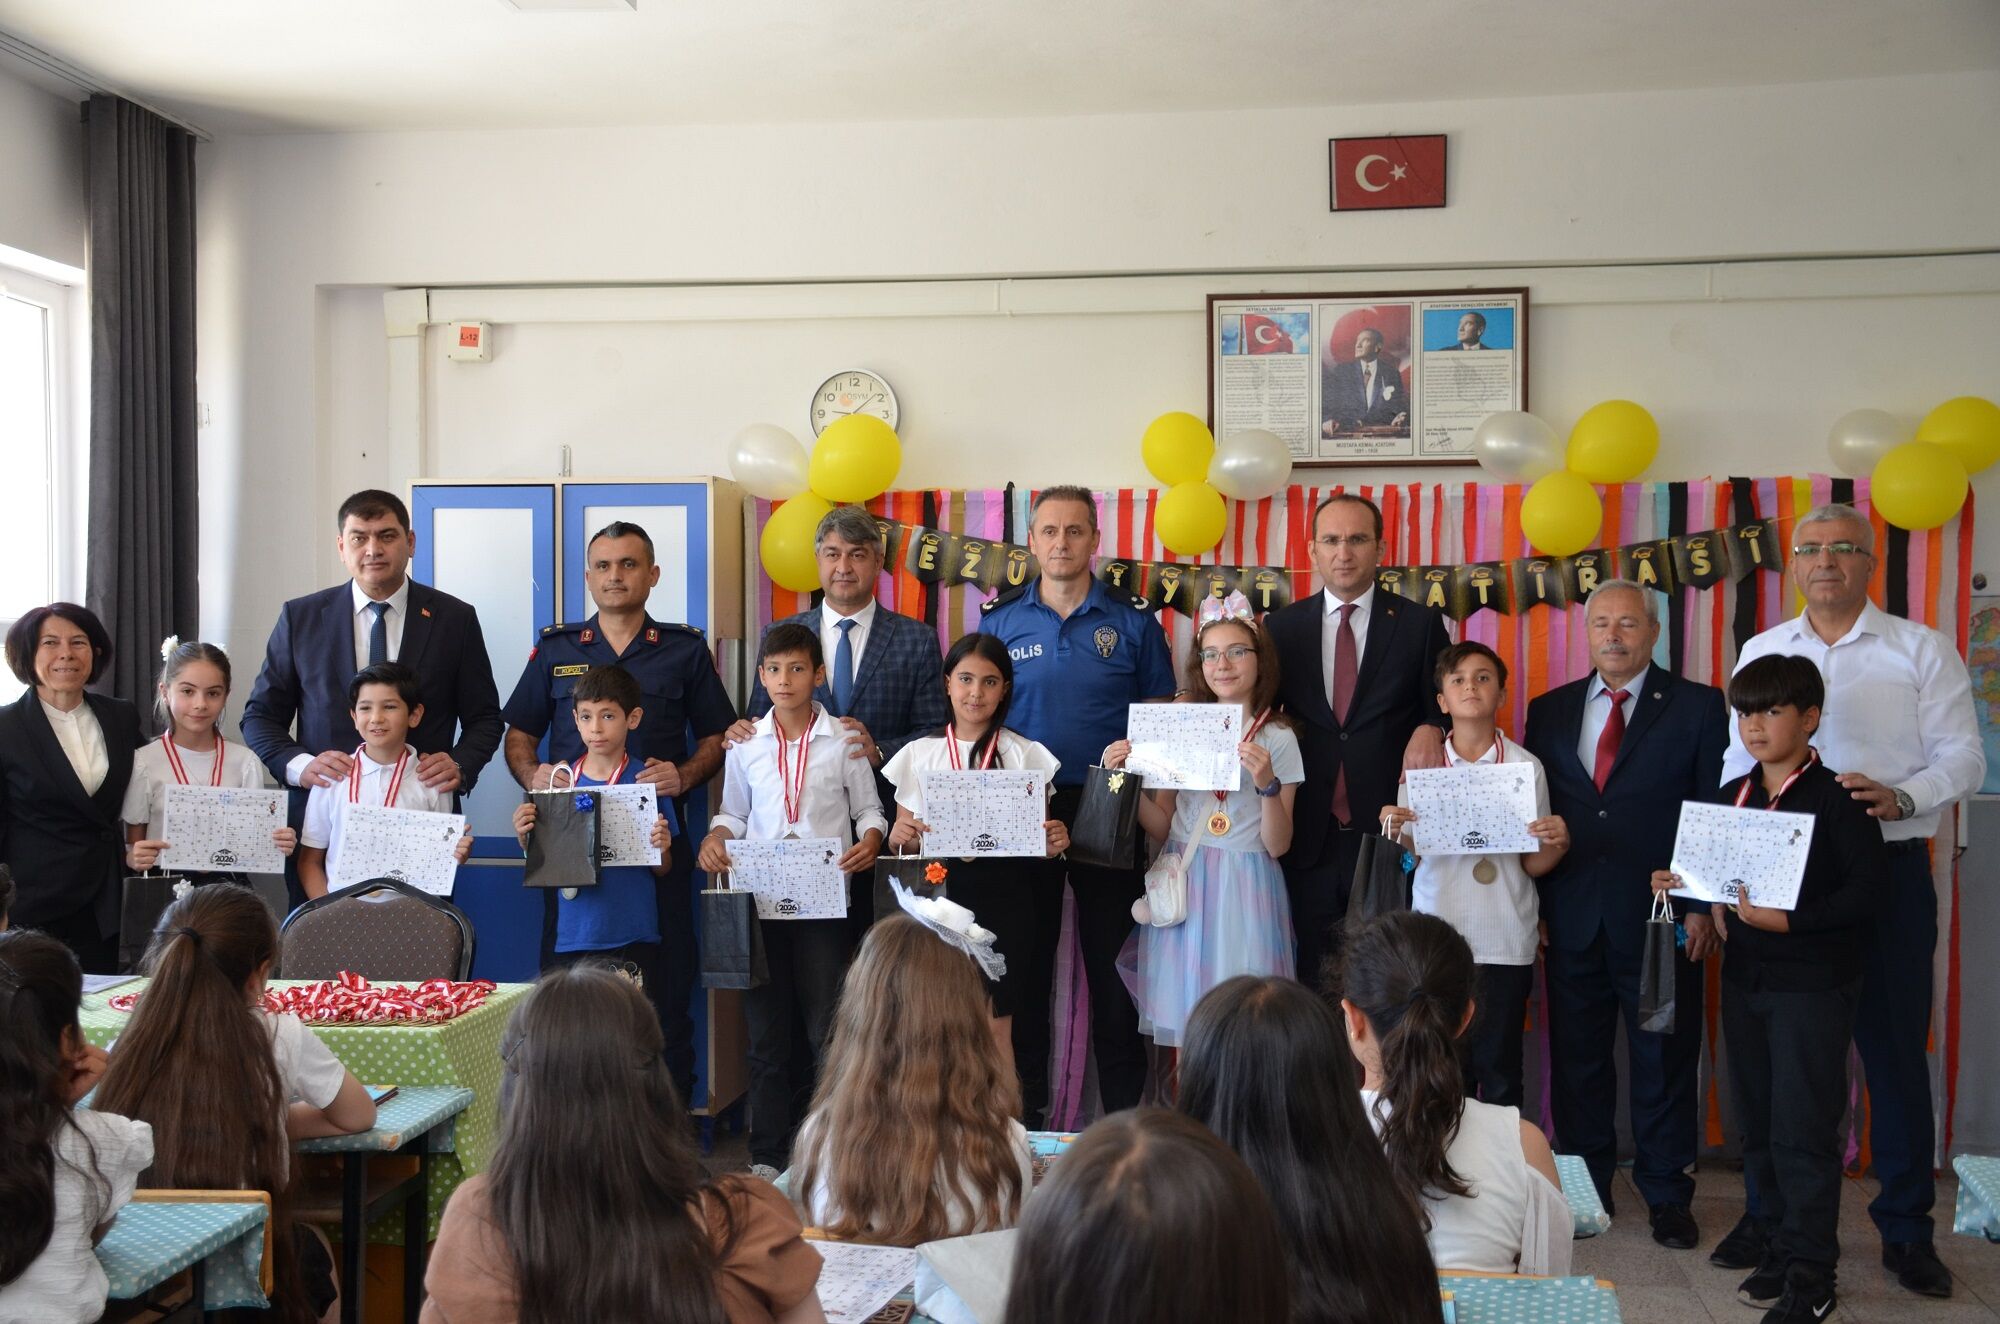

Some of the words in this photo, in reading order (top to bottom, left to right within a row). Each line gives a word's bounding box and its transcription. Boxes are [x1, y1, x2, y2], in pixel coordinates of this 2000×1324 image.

[460, 333, 478, 341] L-12
[835, 382, 842, 391] 11
[850, 378, 860, 387] 12
[824, 393, 835, 402] 10
[877, 393, 884, 402] 2
[817, 409, 825, 418] 9
[882, 410, 889, 419] 3
[975, 840, 995, 848] 2026
[1465, 837, 1485, 845] 2026
[214, 855, 234, 863] 2026
